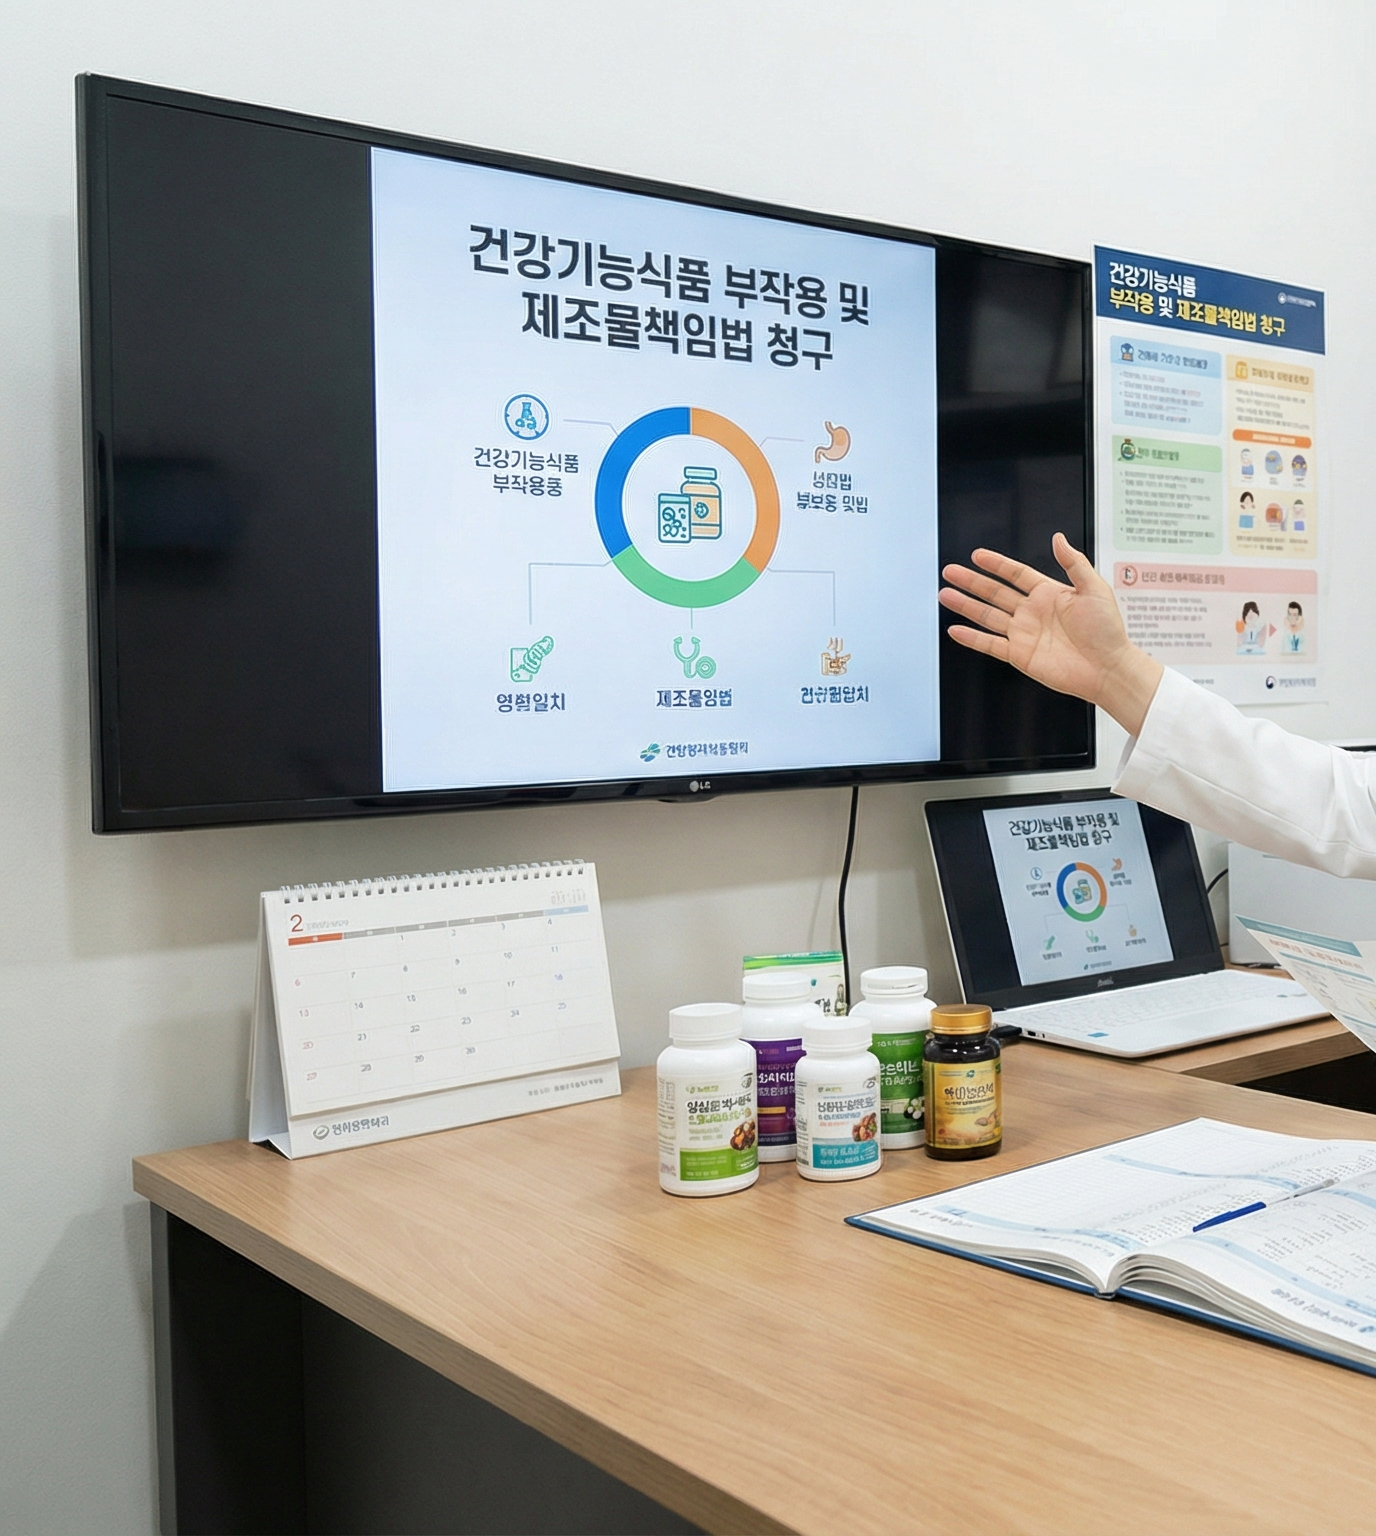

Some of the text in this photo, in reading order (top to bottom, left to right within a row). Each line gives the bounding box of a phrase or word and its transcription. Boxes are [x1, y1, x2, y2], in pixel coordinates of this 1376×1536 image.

[469, 223, 870, 327] 건강기능식품 부작용 및
[1158, 295, 1174, 319] 및
[521, 290, 834, 371] 제조물책임법 청구
[473, 447, 579, 473] 건강기능식품
[290, 914, 303, 933] 2
